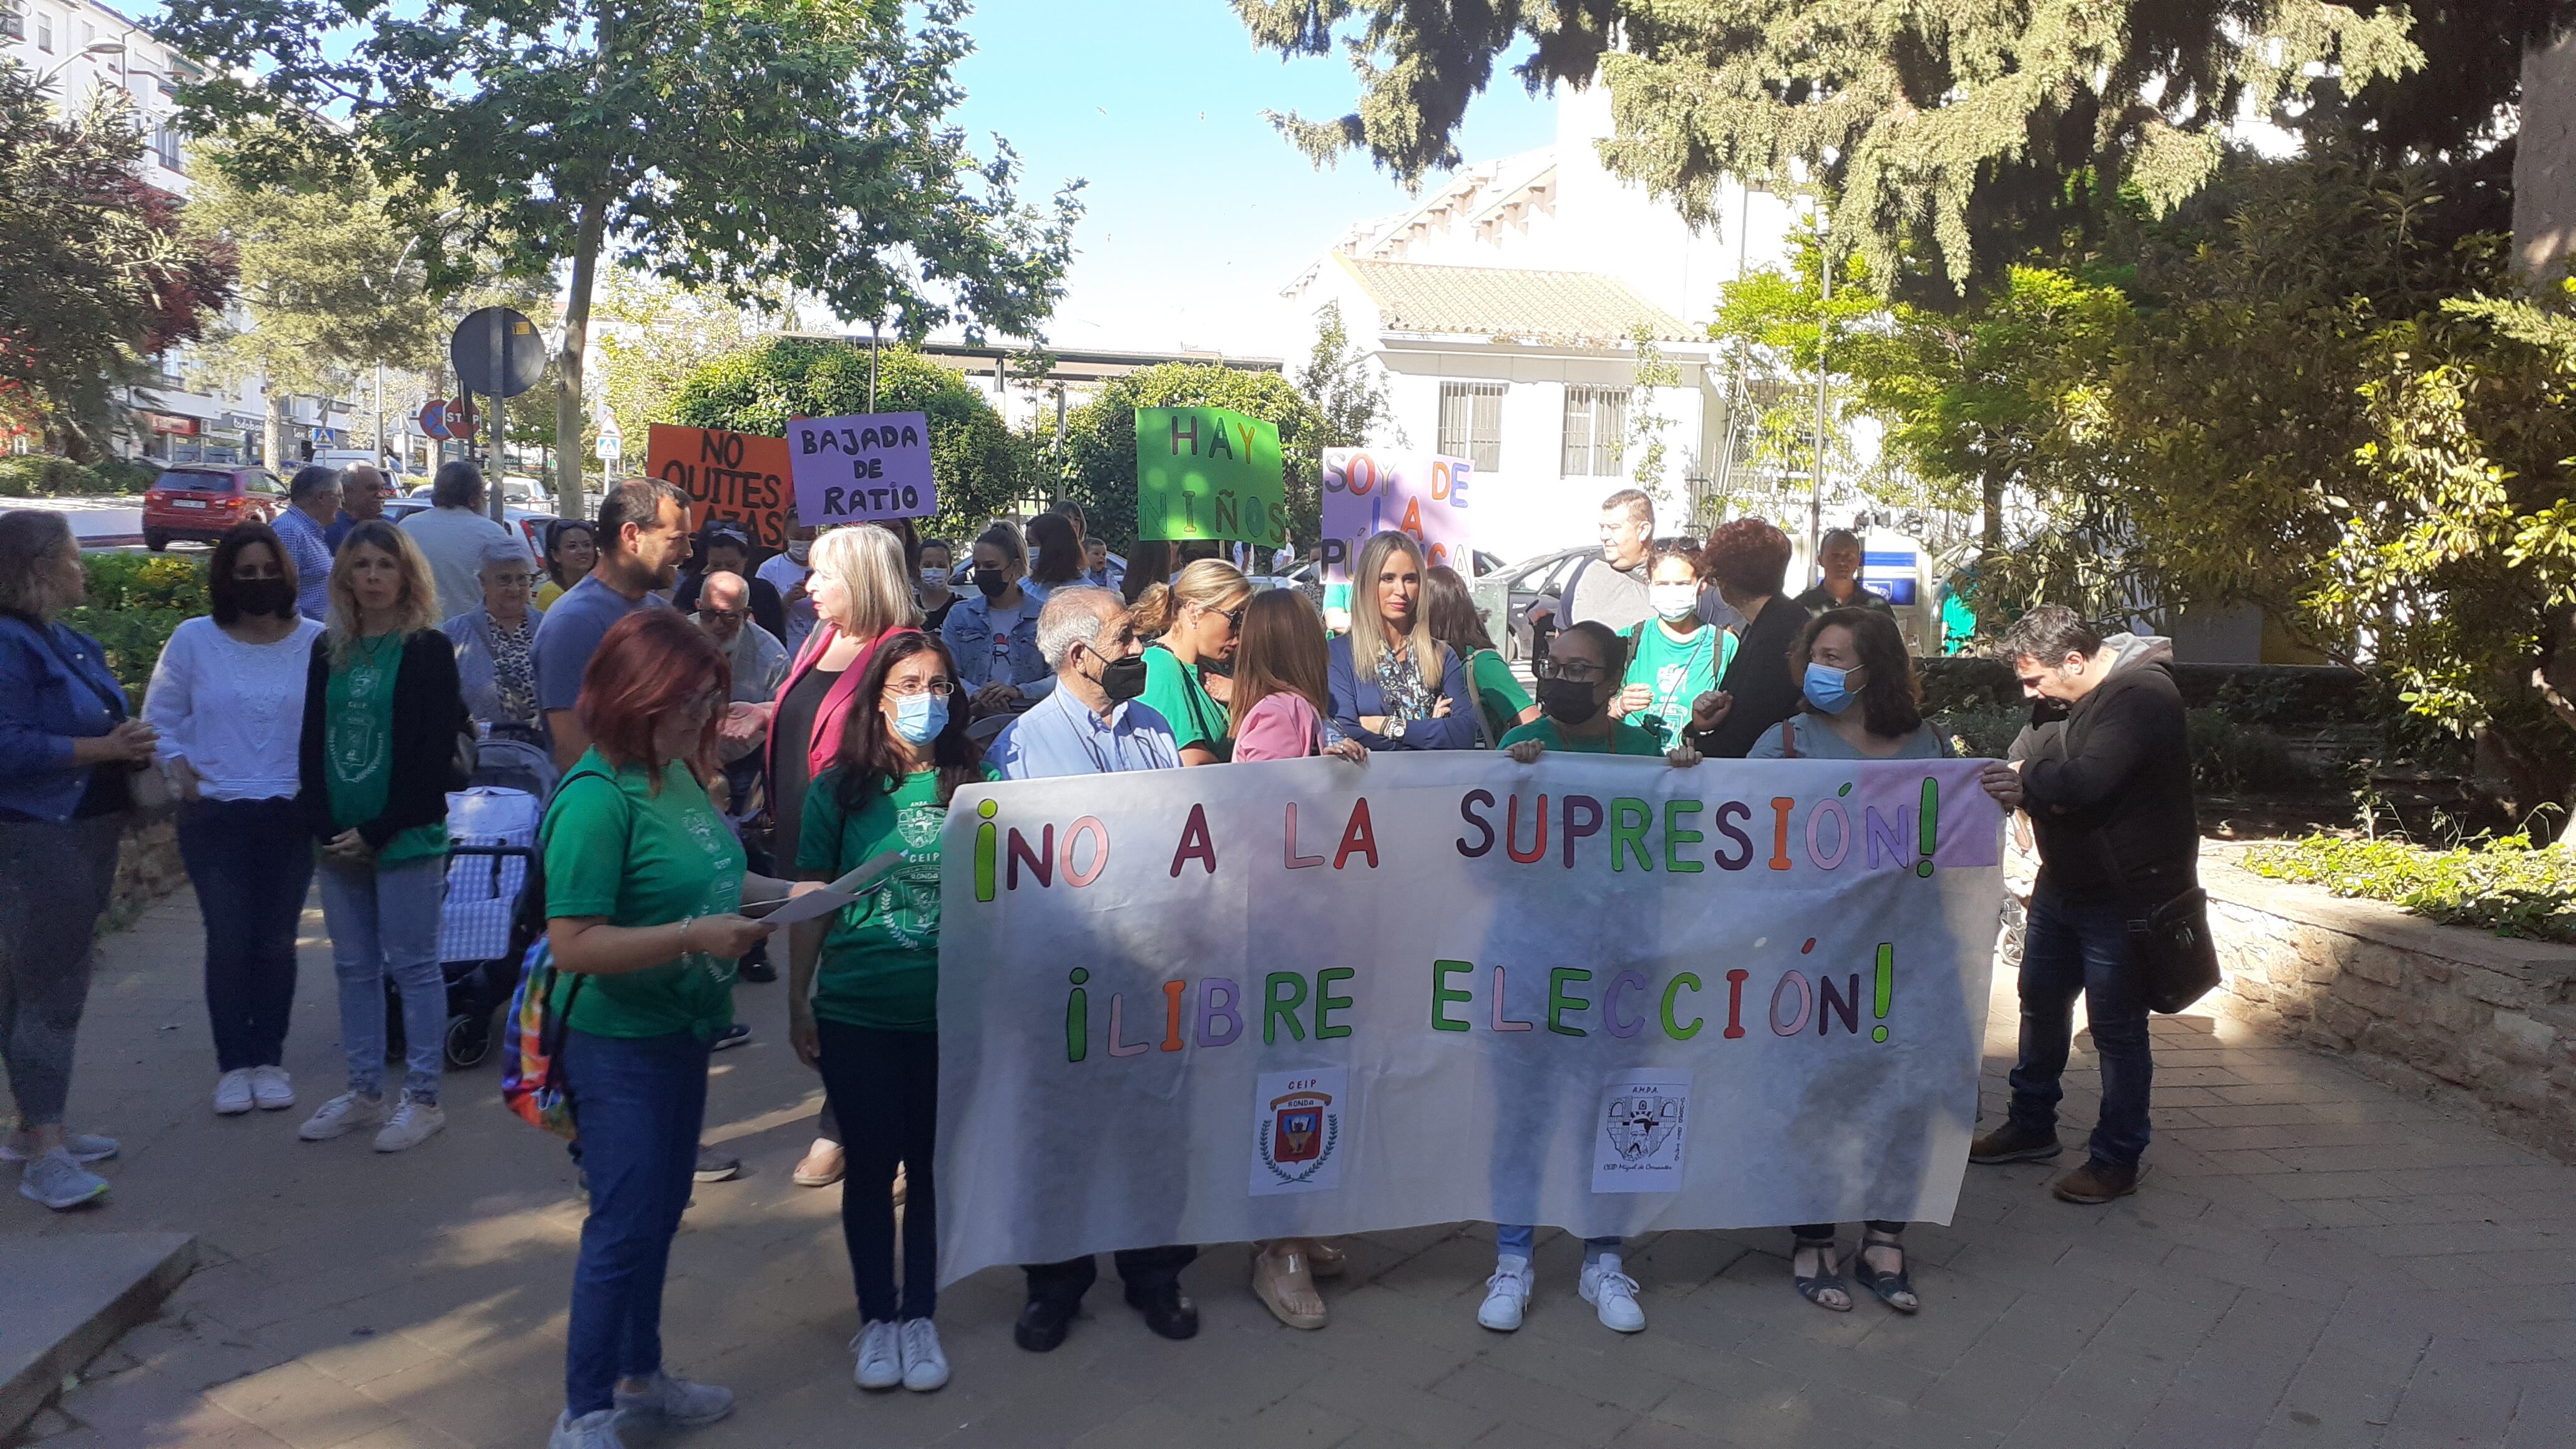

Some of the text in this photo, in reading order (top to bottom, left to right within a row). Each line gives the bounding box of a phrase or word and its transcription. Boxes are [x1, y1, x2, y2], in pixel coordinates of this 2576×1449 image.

[447, 412, 479, 424] STP
[700, 430, 744, 469] NO
[801, 425, 919, 456] BAJADA
[1171, 415, 1256, 464] HAY
[853, 458, 884, 479] DE
[1324, 452, 1470, 509] SOY DE
[1139, 489, 1286, 544] NIÑOS
[1169, 803, 1217, 878] A
[1284, 796, 1379, 870] LA
[1456, 776, 1940, 879] SUPRESIÓN!
[909, 852, 940, 863] CEIP
[1431, 937, 1894, 1043] ELECCIÓN!
[1288, 1079, 1317, 1090] CEIP
[1288, 1100, 1314, 1108] RONDA
